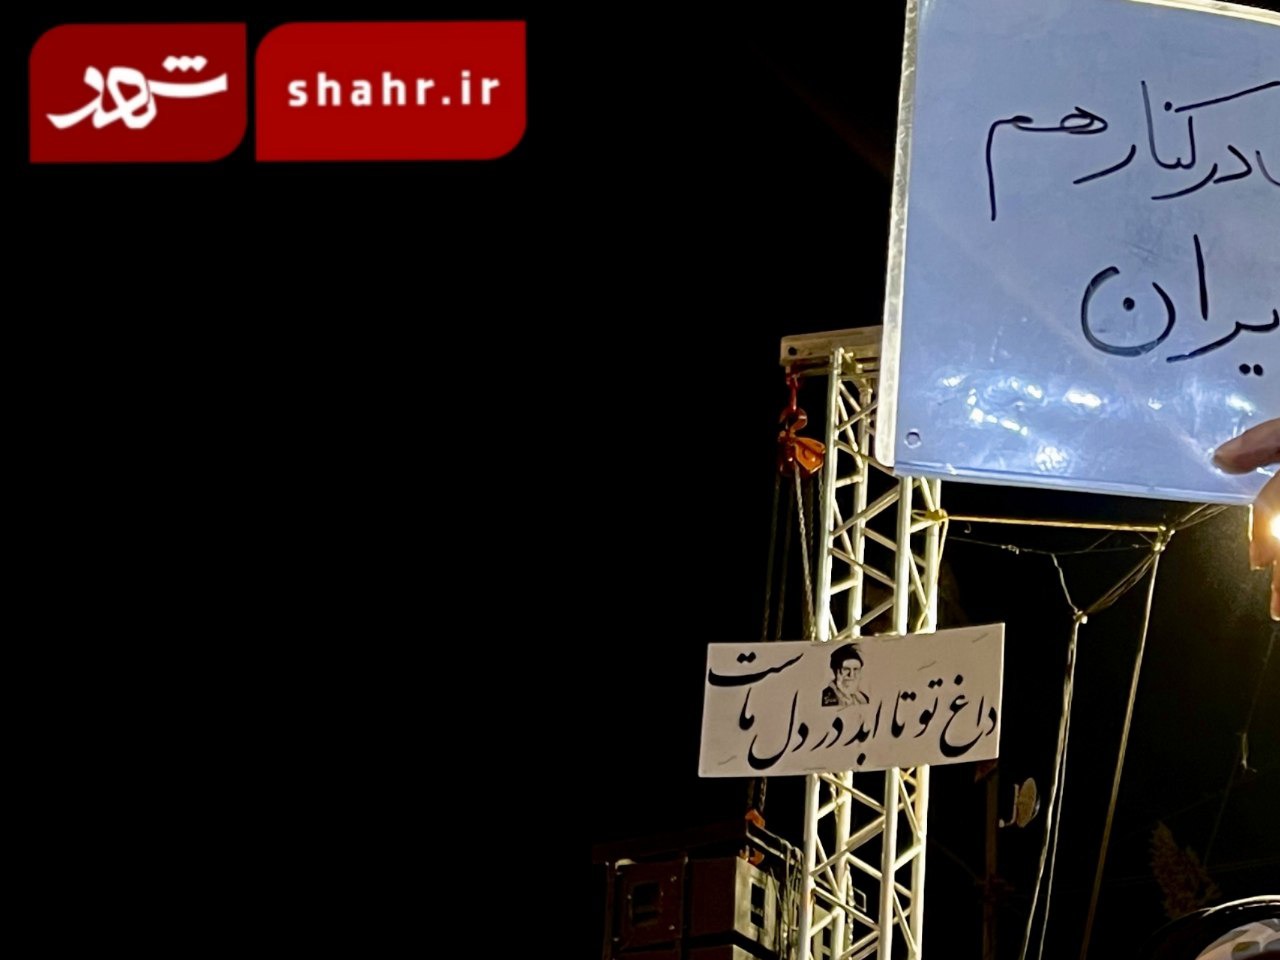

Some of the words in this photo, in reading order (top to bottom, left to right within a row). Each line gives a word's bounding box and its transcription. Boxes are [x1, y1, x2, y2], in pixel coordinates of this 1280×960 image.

[985, 107, 1109, 222] هم
[1151, 145, 1253, 200] در
[747, 690, 809, 770] دل
[810, 716, 844, 752] در
[844, 700, 883, 766] ابد
[890, 689, 916, 738] تا
[914, 677, 944, 738] تو
[939, 674, 998, 758] داغ
